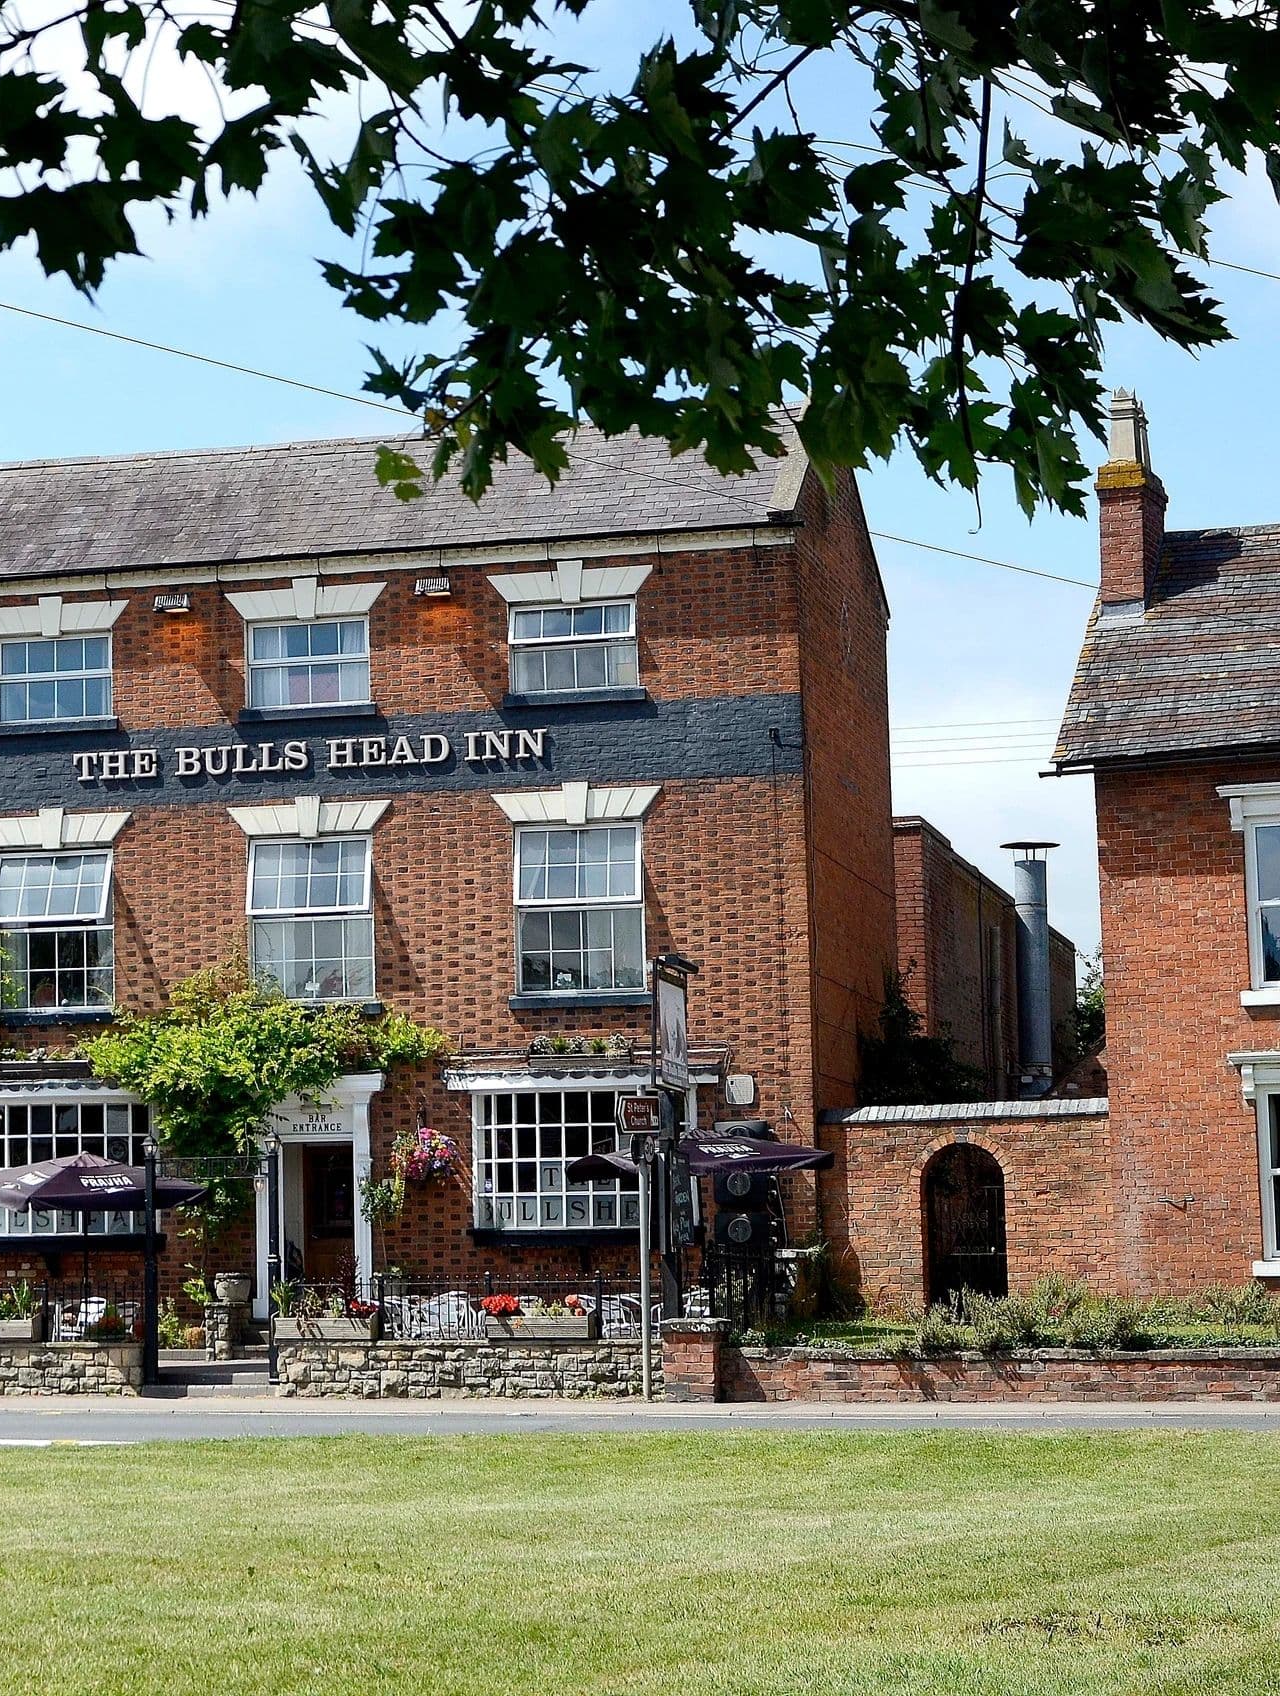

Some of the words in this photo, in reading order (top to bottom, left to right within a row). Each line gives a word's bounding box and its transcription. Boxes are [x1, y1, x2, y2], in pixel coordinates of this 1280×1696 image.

[73, 749, 157, 782] THE
[174, 741, 308, 777] BULLS
[326, 733, 451, 768] HEAD
[463, 728, 548, 762] INN
[626, 1102, 633, 1113] St
[634, 1102, 650, 1113] Peter's
[308, 1114, 326, 1123] BAR
[630, 1115, 647, 1126] Church
[292, 1123, 342, 1132] ENTRANCE
[80, 1176, 133, 1187] PRAVHA
